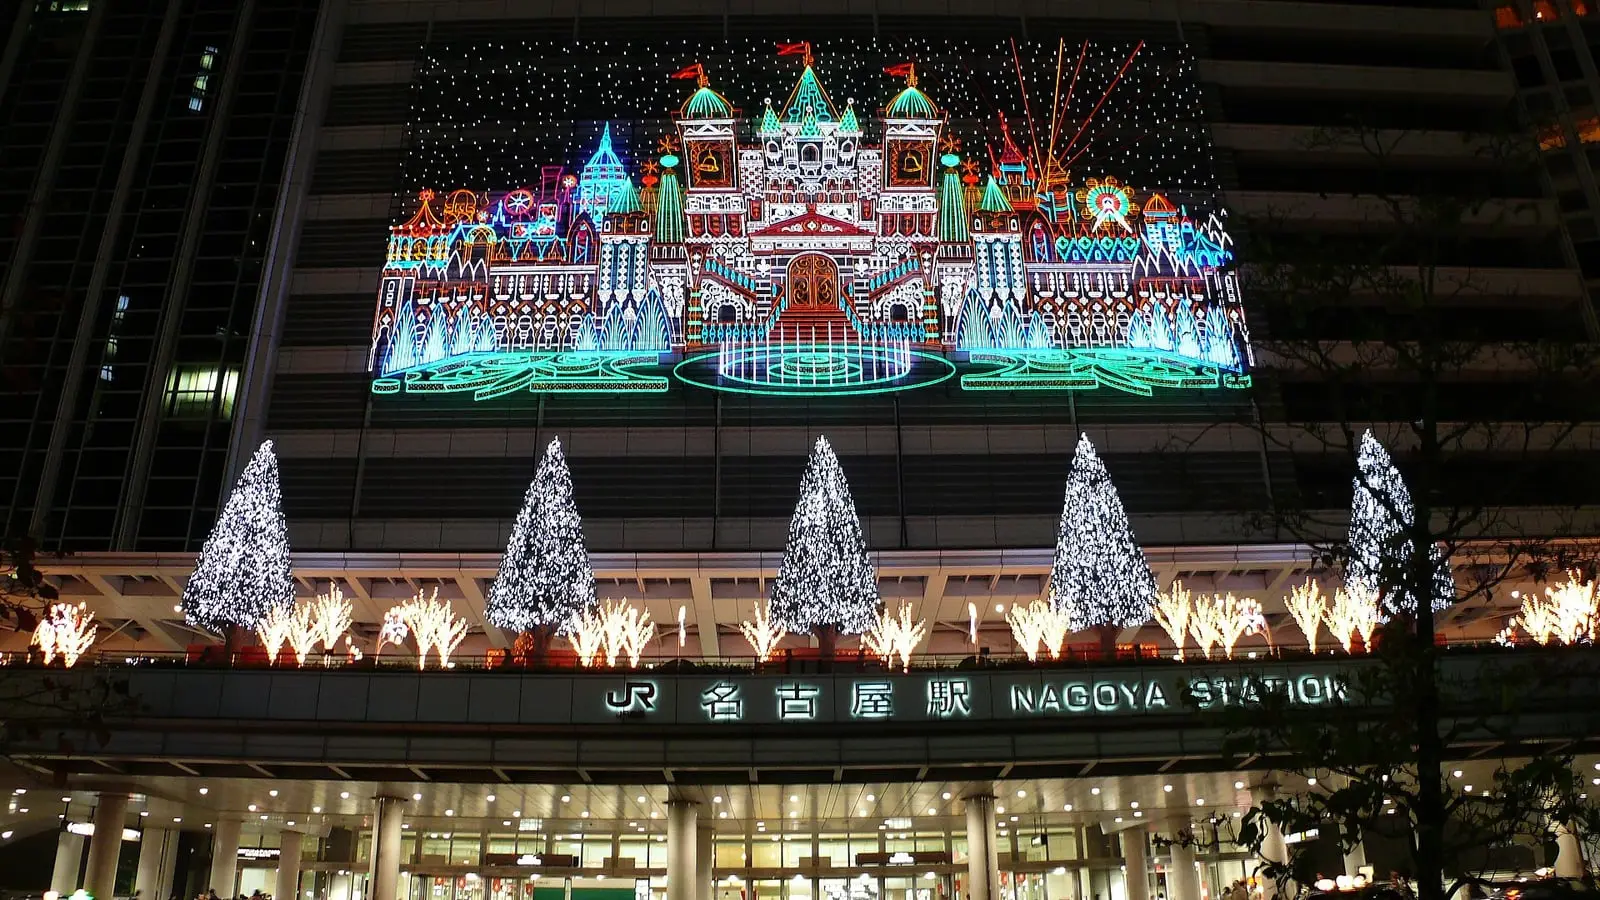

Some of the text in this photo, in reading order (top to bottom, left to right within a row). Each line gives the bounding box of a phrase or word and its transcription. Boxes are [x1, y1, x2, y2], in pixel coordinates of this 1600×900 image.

[606, 682, 656, 710] JR
[701, 680, 971, 719] 名古屋駅
[1010, 680, 1170, 711] NAGOYA
